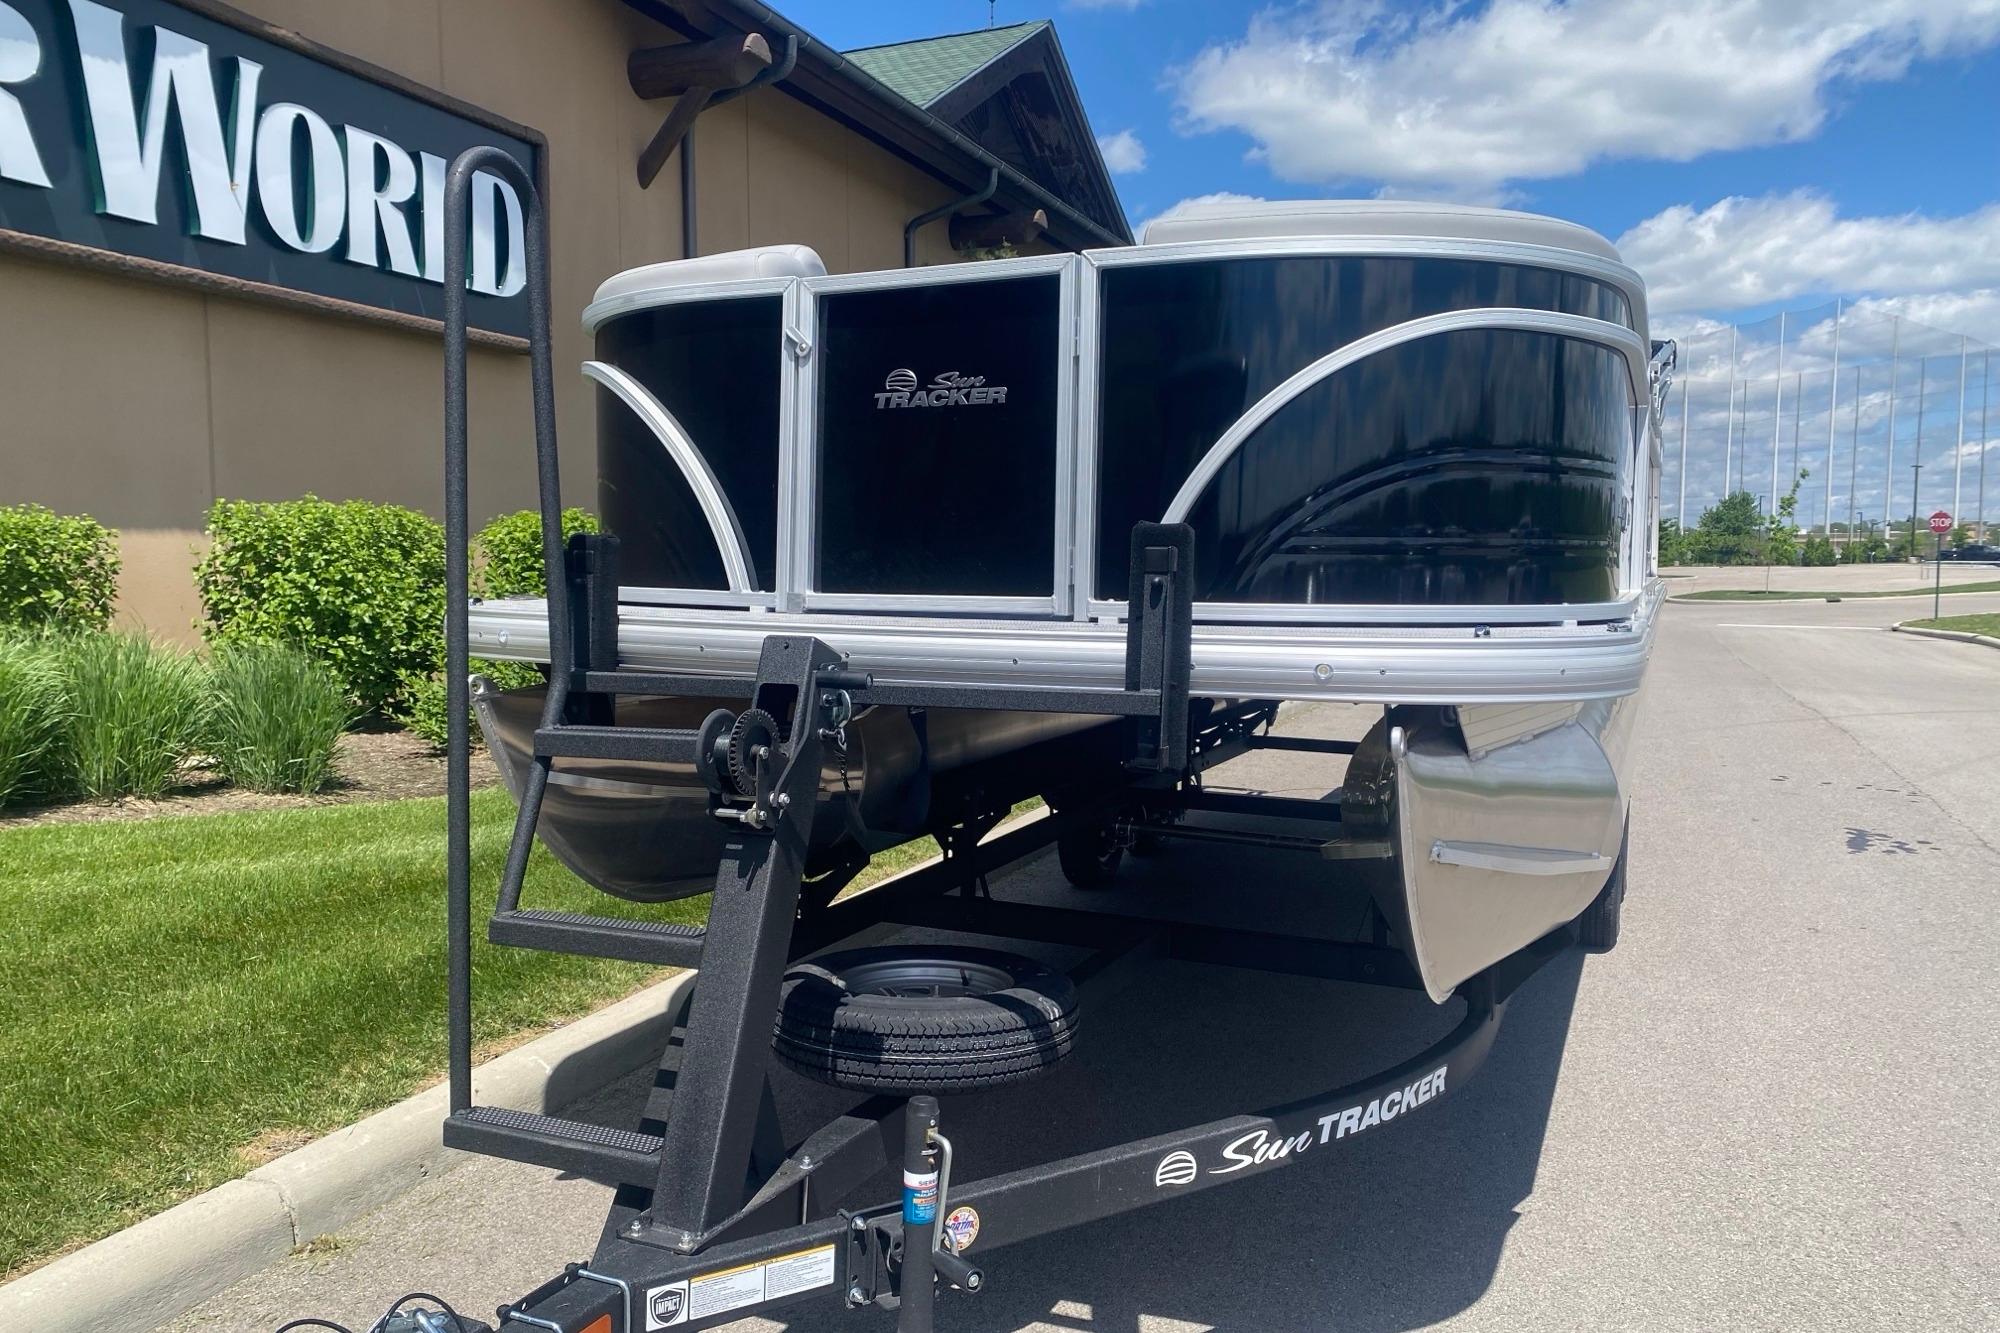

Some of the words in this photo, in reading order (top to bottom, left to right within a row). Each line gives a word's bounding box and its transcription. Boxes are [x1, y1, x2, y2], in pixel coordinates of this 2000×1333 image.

[68, 0, 527, 297] WORLD
[928, 371, 986, 388] Sun
[874, 386, 1008, 409] TRACKER
[1930, 517, 1952, 527] STOP
[1208, 1129, 1313, 1174] Sun
[1318, 1065, 1448, 1145] TRACKER
[655, 1297, 681, 1315] IMPACT
